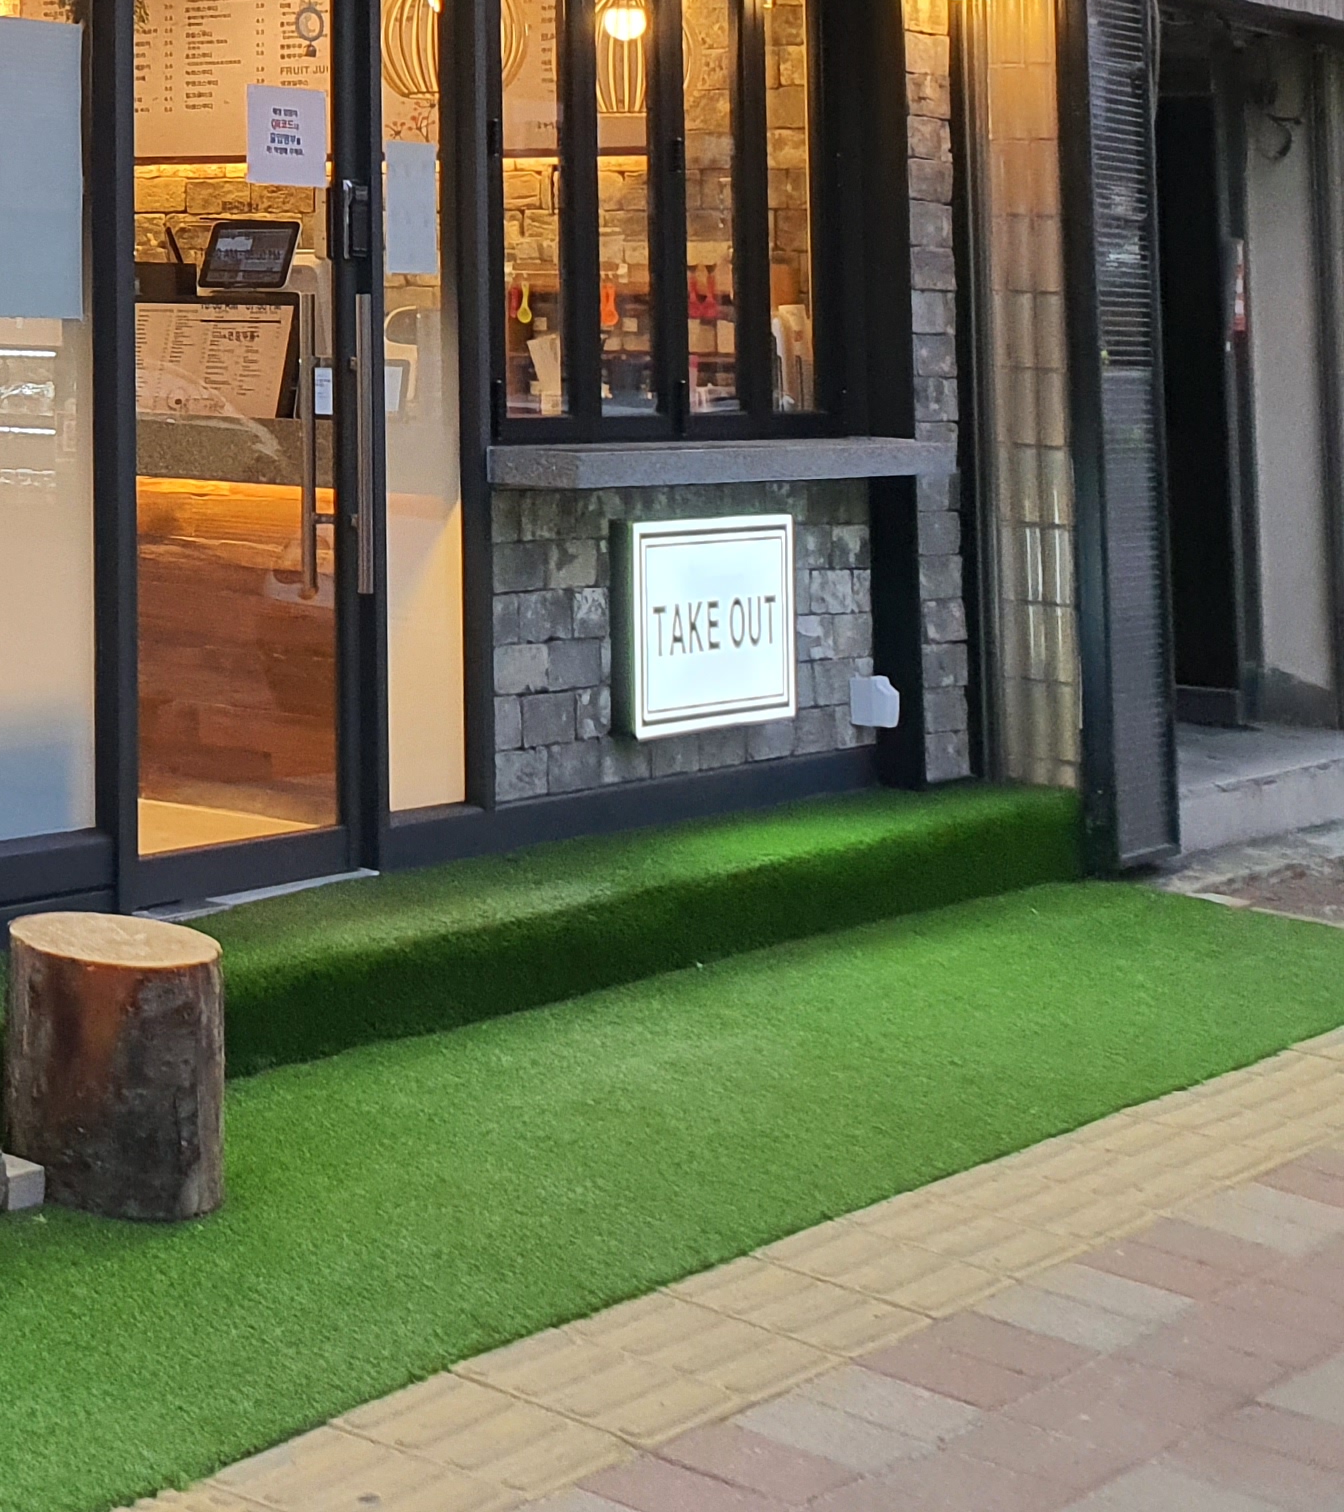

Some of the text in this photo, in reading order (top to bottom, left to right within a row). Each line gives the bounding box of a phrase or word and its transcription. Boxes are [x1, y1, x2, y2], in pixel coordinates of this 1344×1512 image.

[279, 66, 310, 75] FRUIT
[652, 595, 777, 657] TAKE OUT
